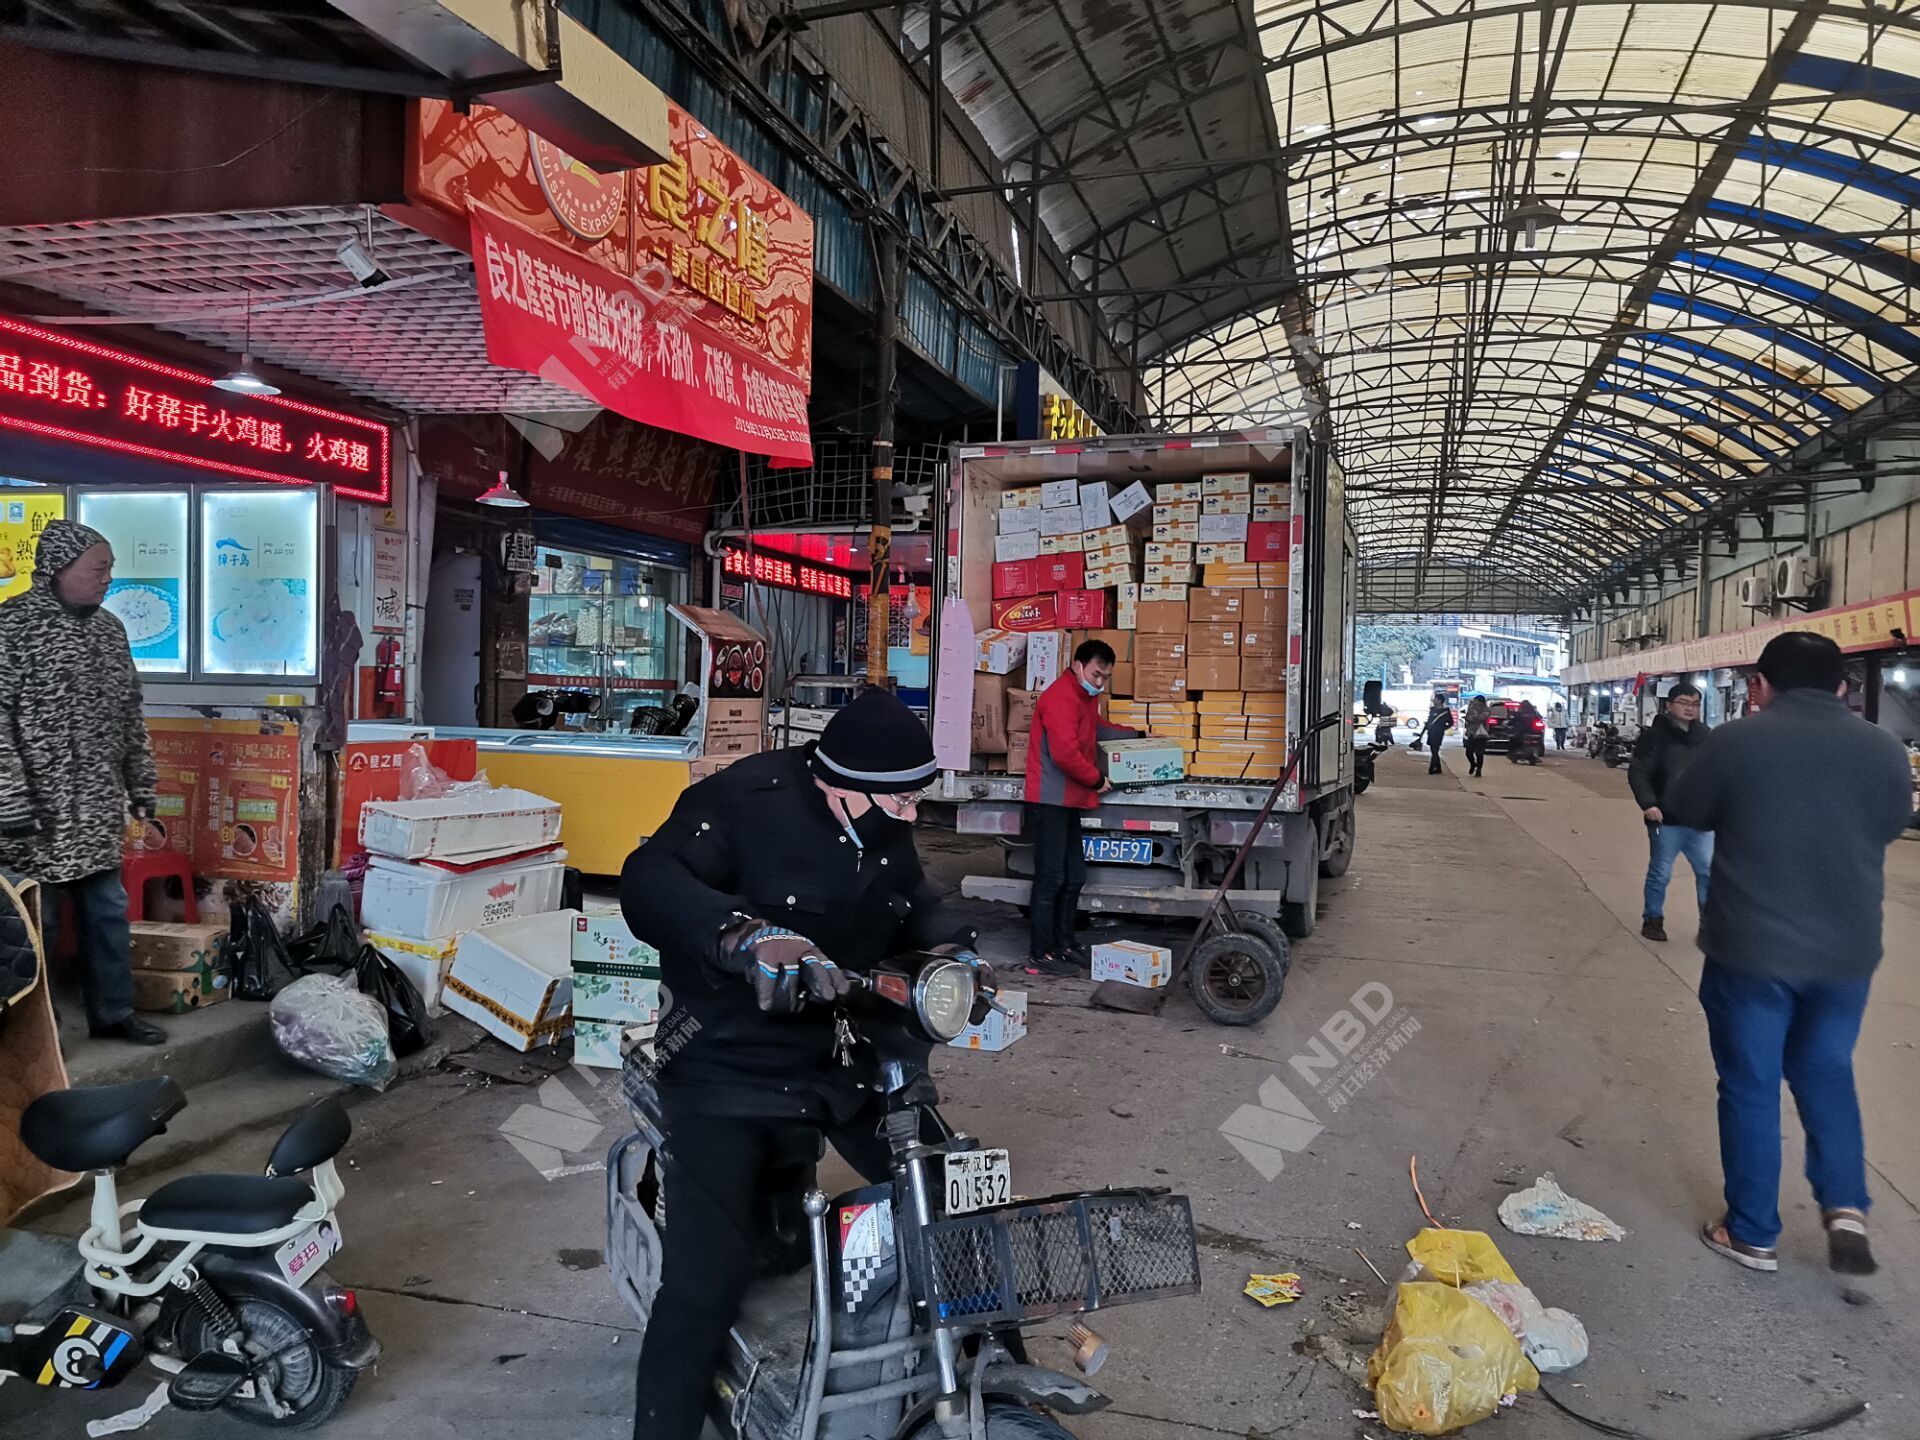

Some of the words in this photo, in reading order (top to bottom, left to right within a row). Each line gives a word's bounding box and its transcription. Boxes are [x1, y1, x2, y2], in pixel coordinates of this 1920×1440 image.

[580, 186, 621, 233] EXPRESS
[218, 553, 250, 567] 獐子岛
[1082, 839, 1151, 860] A·P5F97
[951, 1174, 1007, 1209] 01532
[287, 1240, 320, 1277] 爱玛
